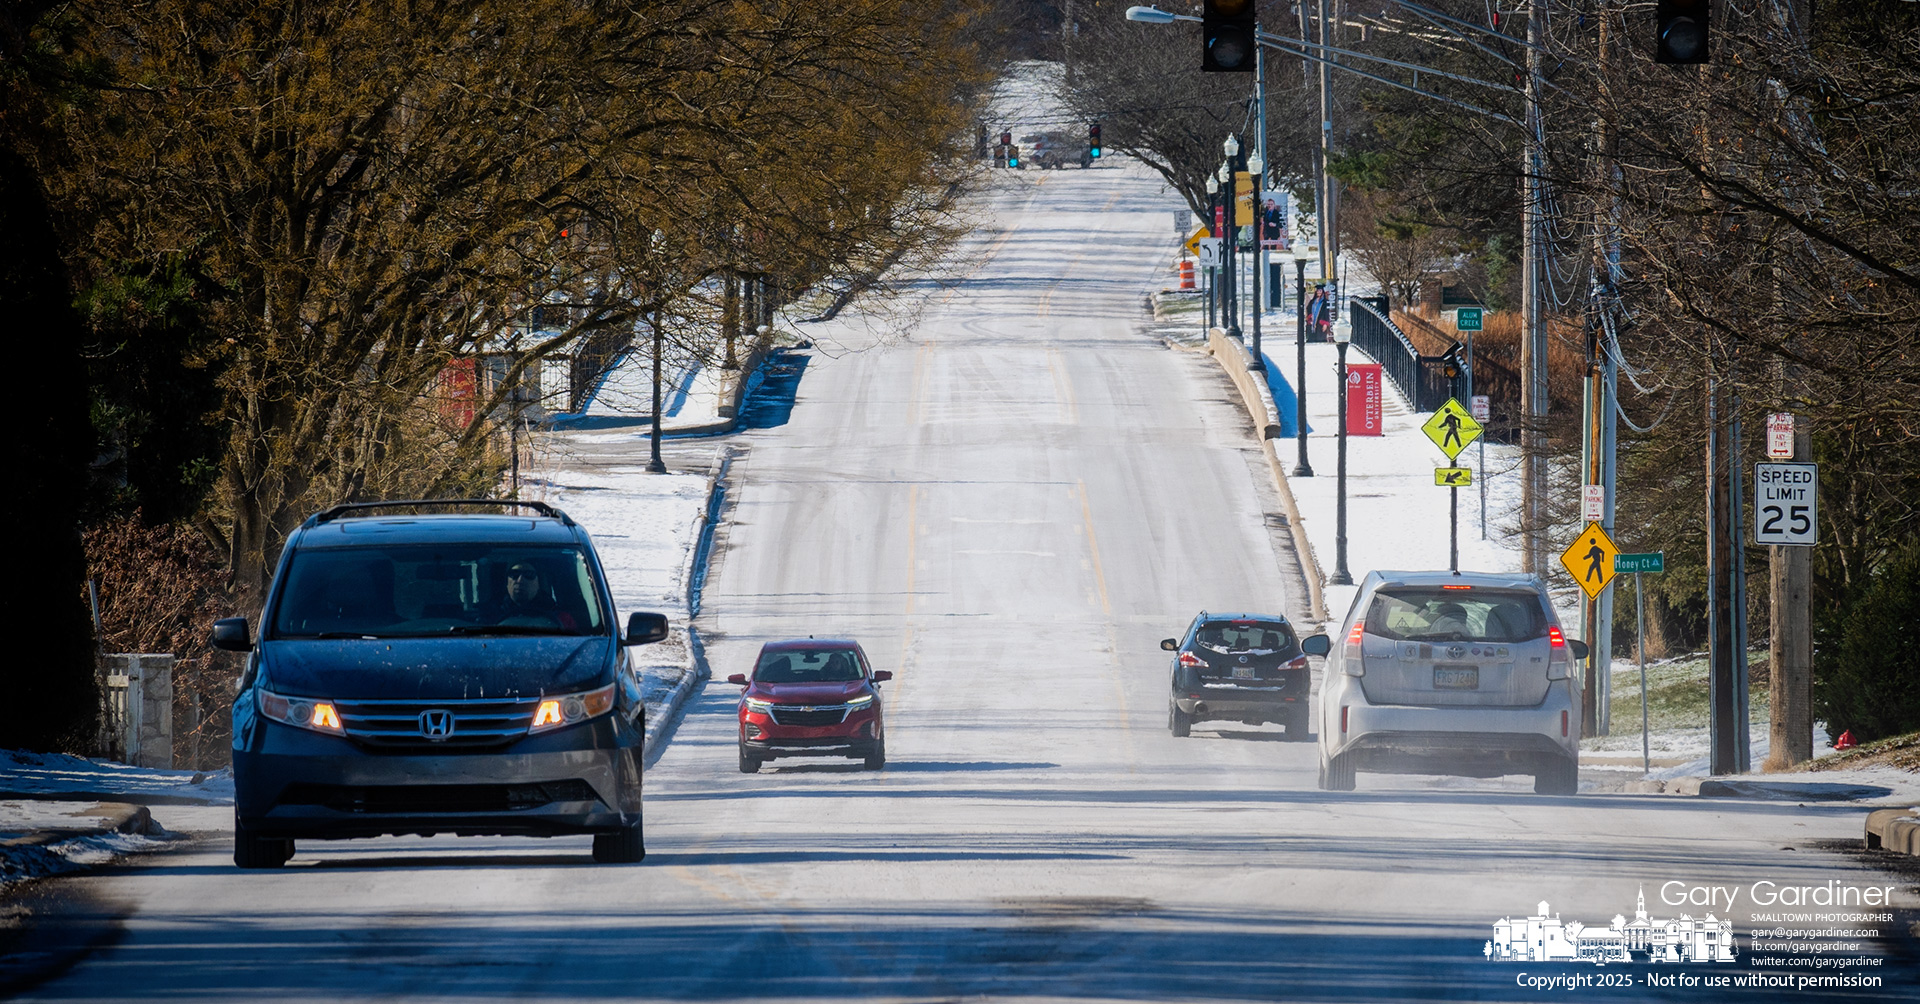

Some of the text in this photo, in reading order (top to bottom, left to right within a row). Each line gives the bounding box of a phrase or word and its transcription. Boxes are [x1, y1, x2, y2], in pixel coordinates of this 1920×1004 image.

[1326, 284, 1336, 309] Here
[1460, 319, 1479, 327] CREEK
[1365, 372, 1374, 429] OTTERBEIN
[1776, 413, 1786, 422] NO
[1761, 471, 1812, 484] SPEED
[1767, 488, 1806, 500] LIMIT
[1762, 505, 1811, 535] 25
[1614, 555, 1650, 571] Honey Ct
